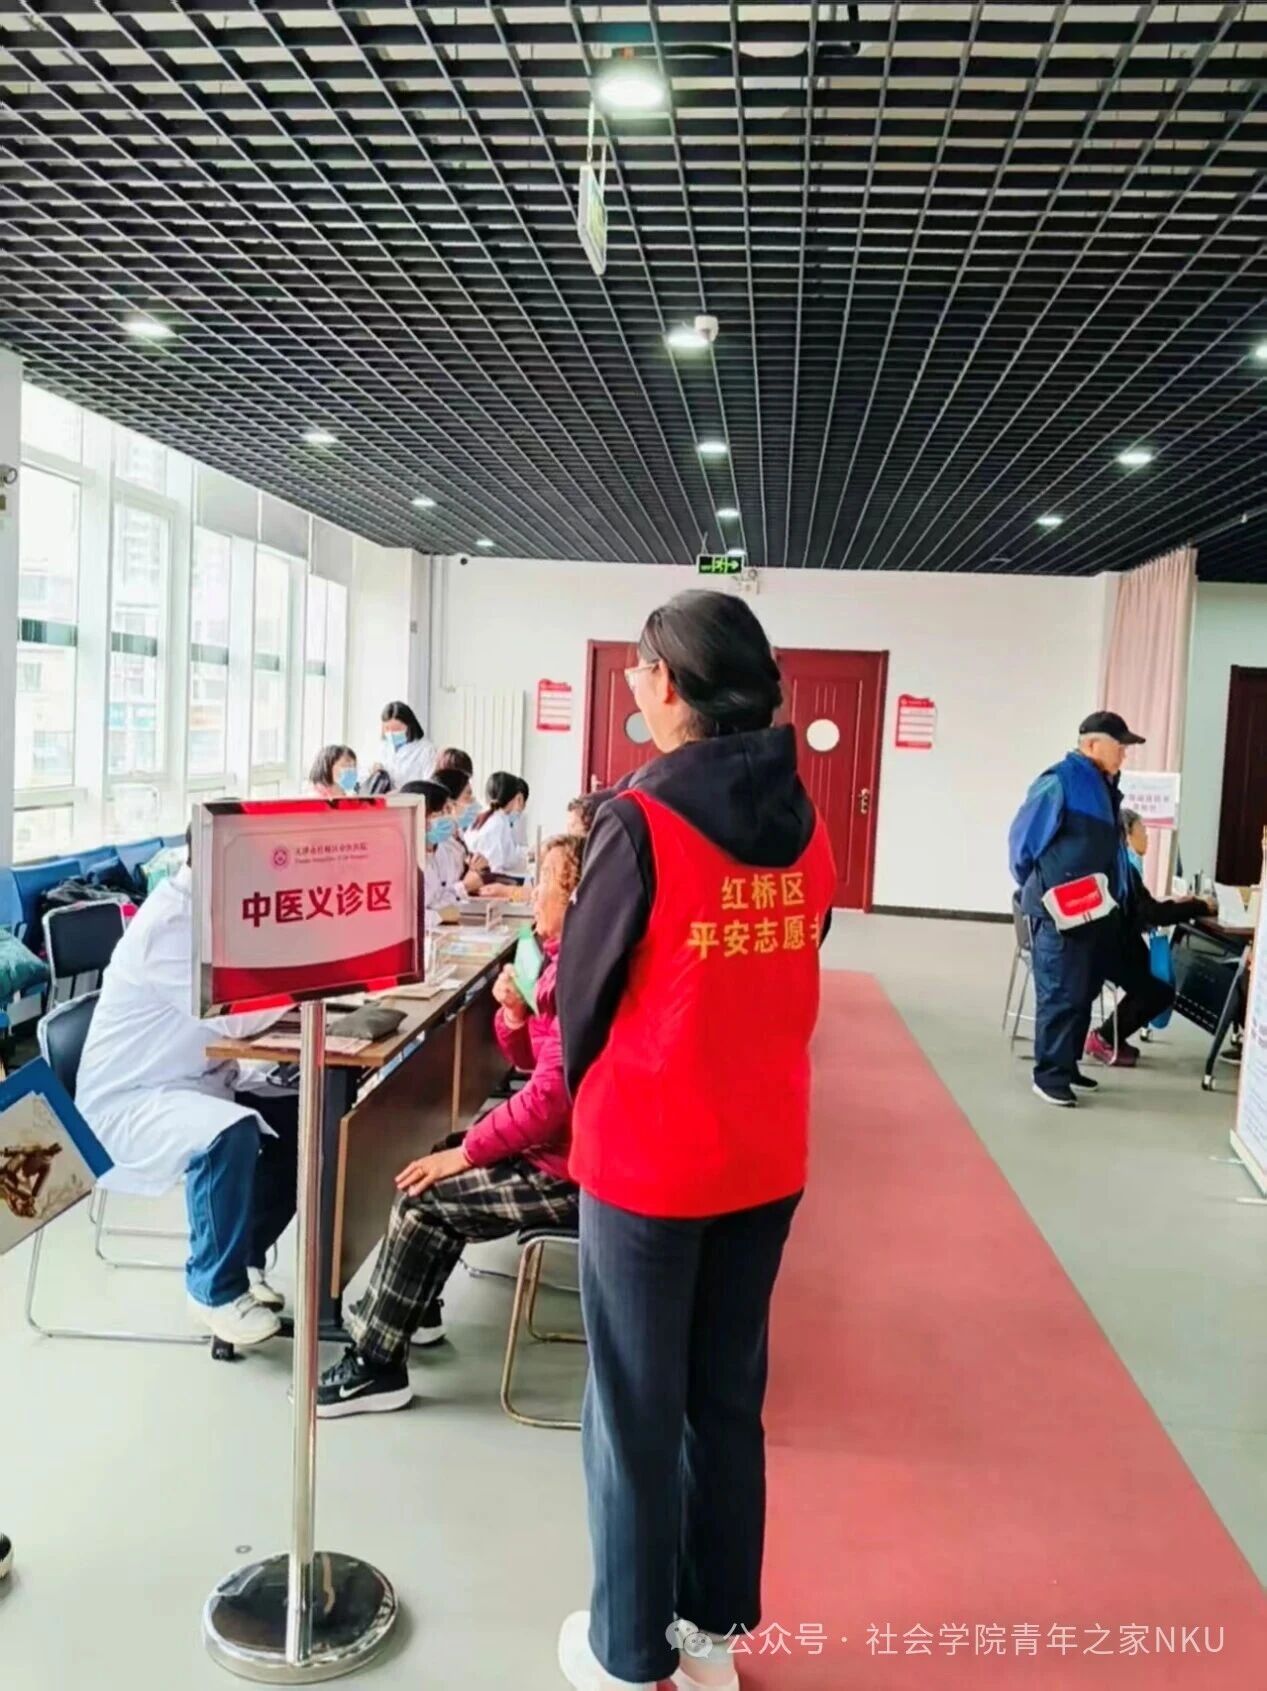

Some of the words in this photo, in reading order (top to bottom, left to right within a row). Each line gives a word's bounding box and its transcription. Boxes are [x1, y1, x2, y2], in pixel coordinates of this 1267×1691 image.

[242, 880, 392, 928] 中医义诊区
[721, 872, 805, 910] 红桥区
